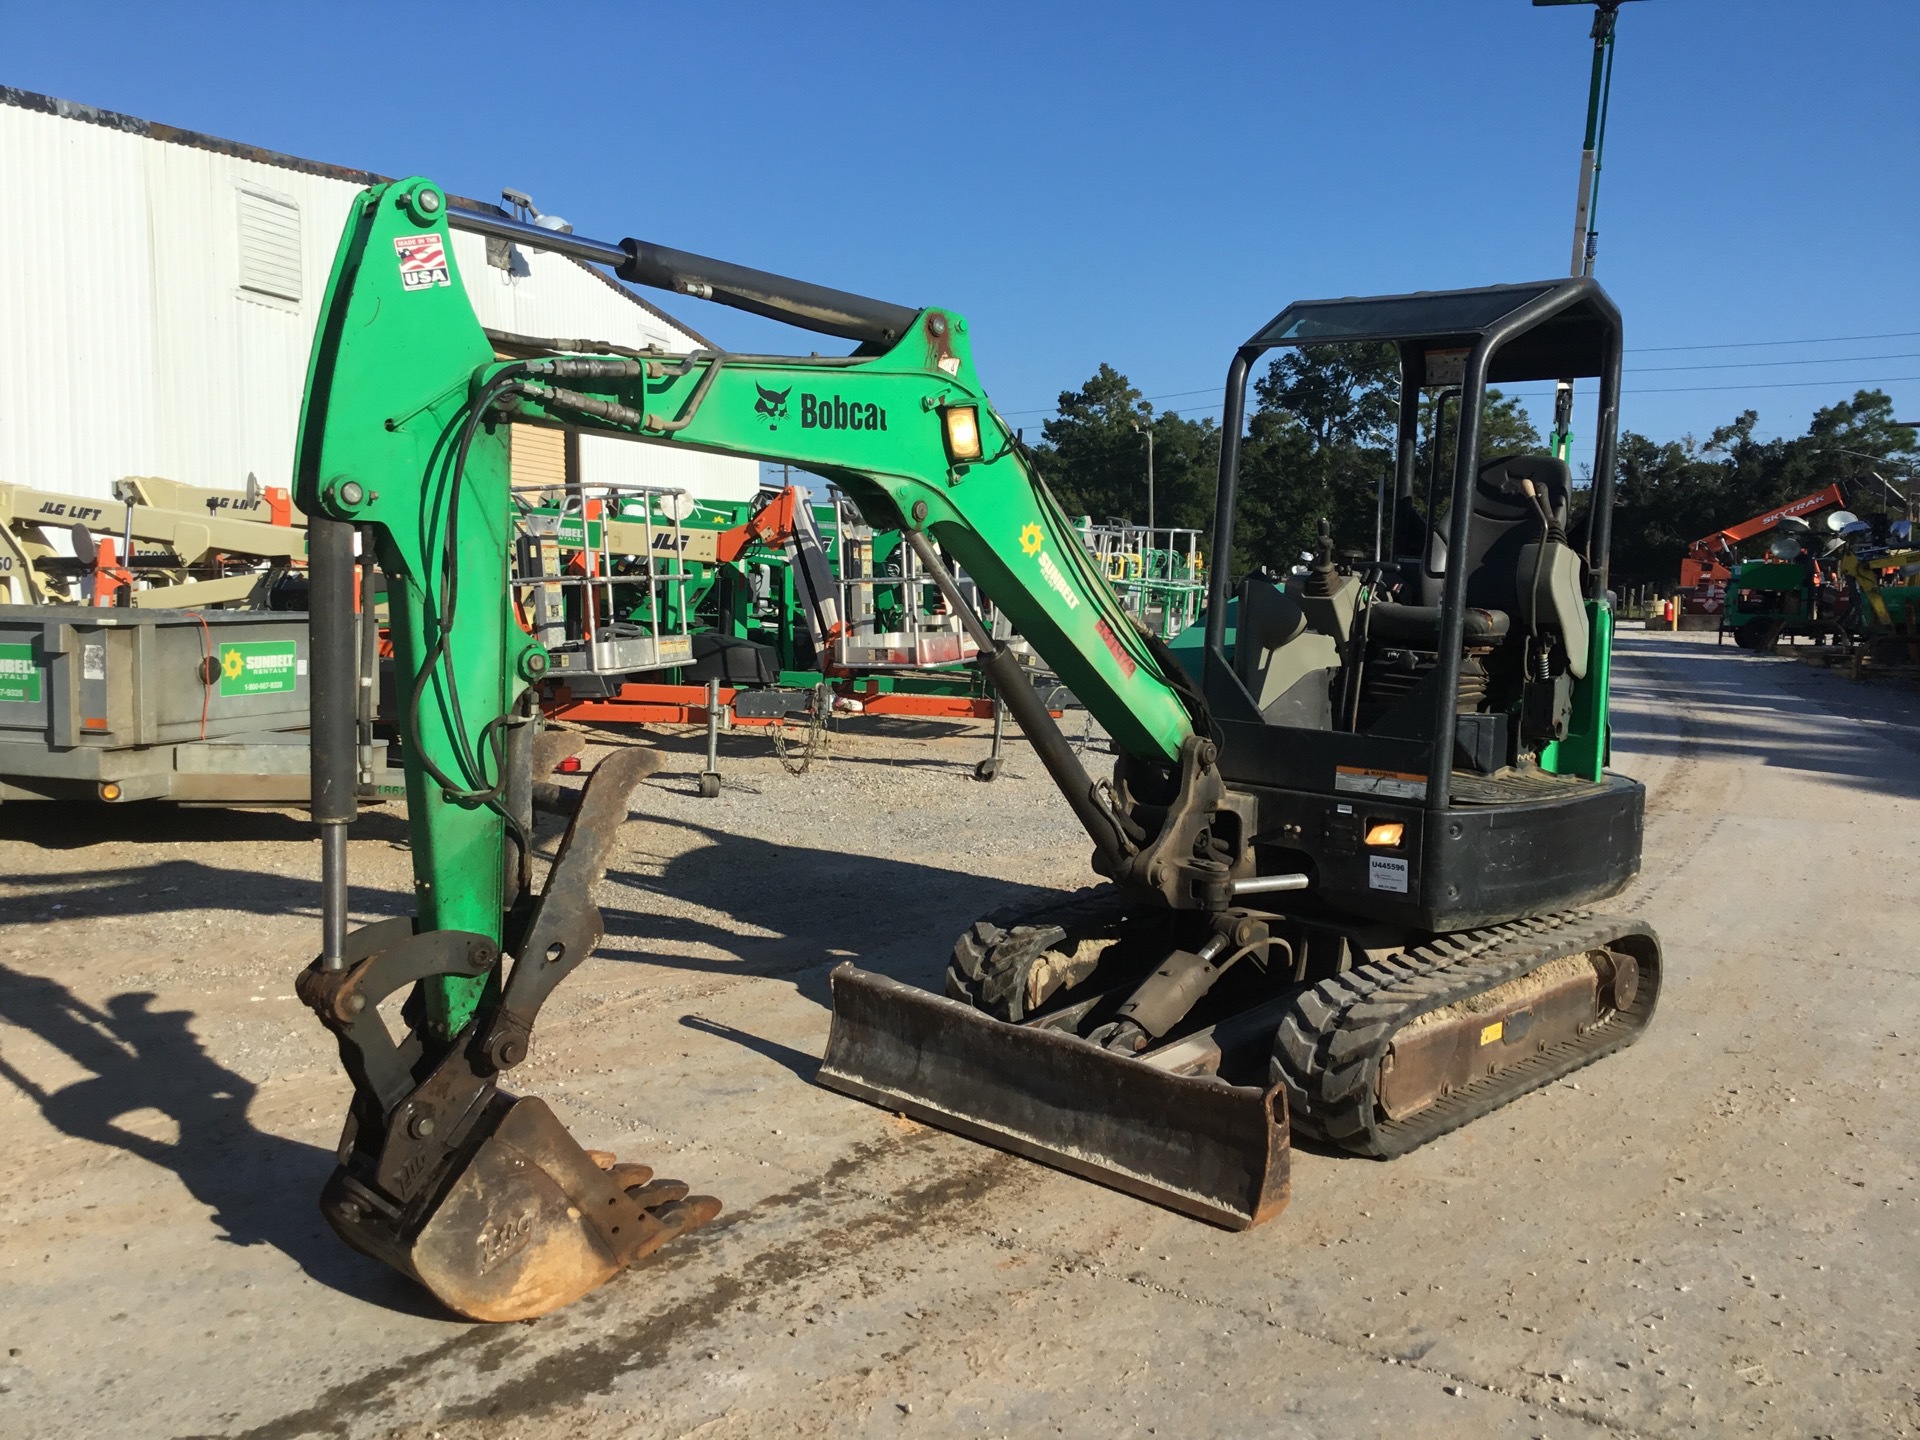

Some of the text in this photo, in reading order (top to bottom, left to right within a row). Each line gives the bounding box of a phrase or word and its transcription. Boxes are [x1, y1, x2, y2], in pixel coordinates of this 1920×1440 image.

[397, 239, 417, 247] MADE
[404, 269, 447, 285] USA
[801, 393, 887, 431] Bobcat
[39, 501, 103, 521] JLG LIFT
[1763, 495, 1825, 525] SKYTRAK
[652, 533, 690, 552] JLG
[1038, 551, 1080, 610] SUNBELT
[246, 654, 294, 669] SUNBELT
[253, 667, 287, 675] RENTALS
[1372, 861, 1405, 872] U445596
